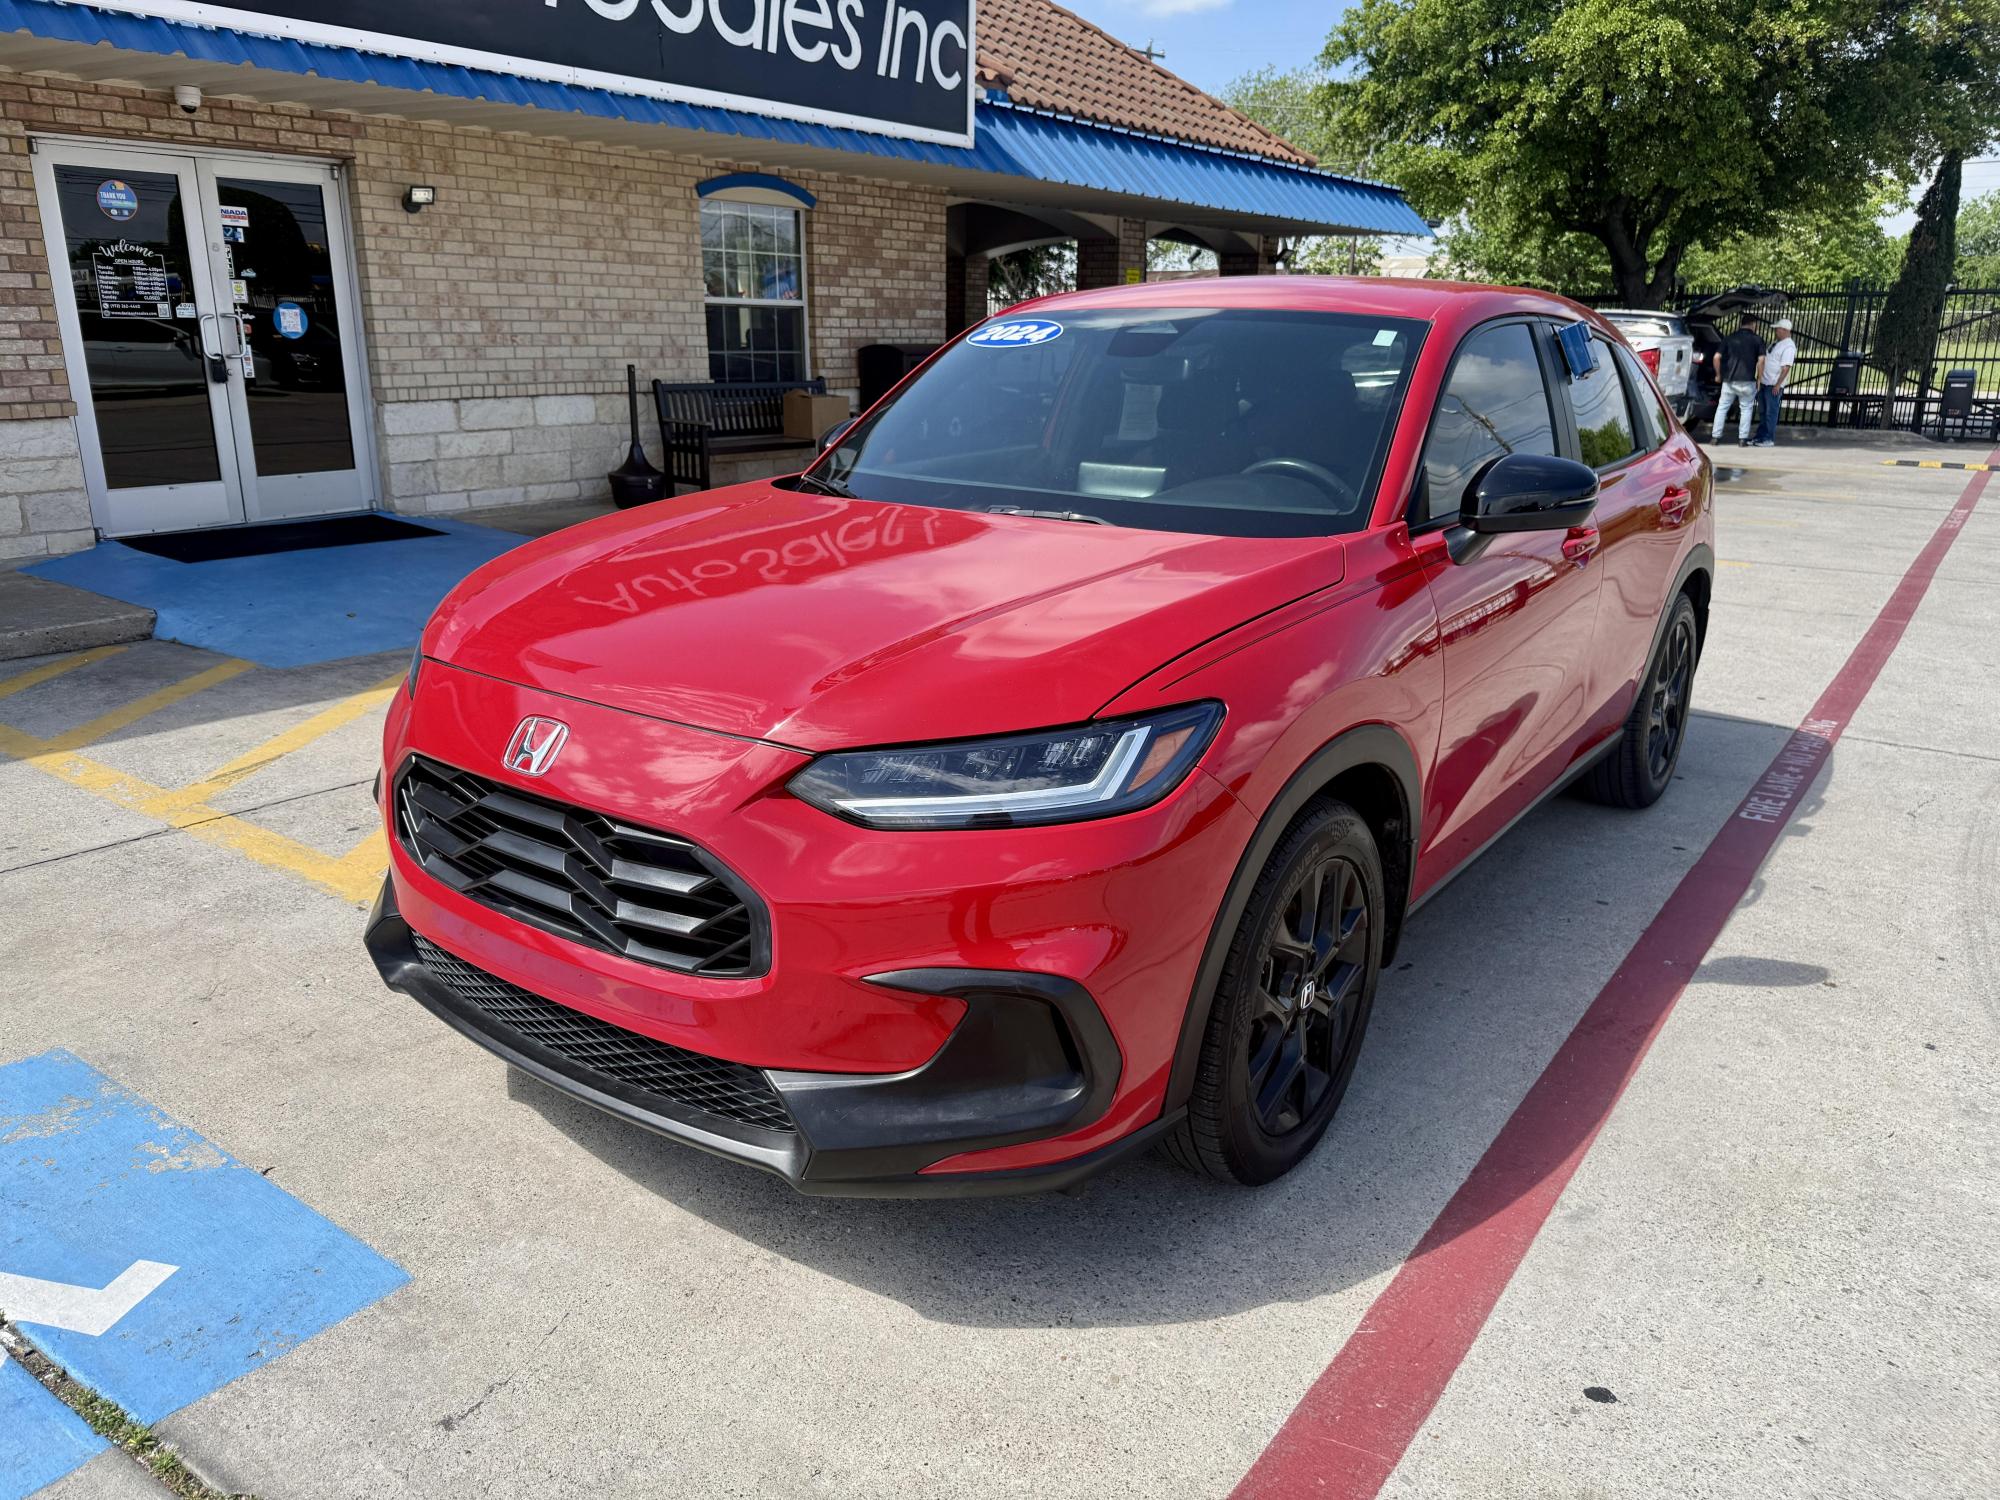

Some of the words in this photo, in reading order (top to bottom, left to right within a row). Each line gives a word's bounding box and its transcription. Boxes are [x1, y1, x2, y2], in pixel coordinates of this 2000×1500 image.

[876, 0, 967, 91] Inc
[116, 192, 126, 200] YOU
[220, 208, 246, 216] NIADA
[98, 239, 155, 257] Welcome
[971, 325, 1059, 343] 2024
[1789, 718, 1839, 754] PARKING
[1778, 750, 1817, 768] NO
[1753, 771, 1805, 800] LANE
[1738, 796, 1788, 823] FIRE
[1257, 844, 1320, 961] CROSSOVER
